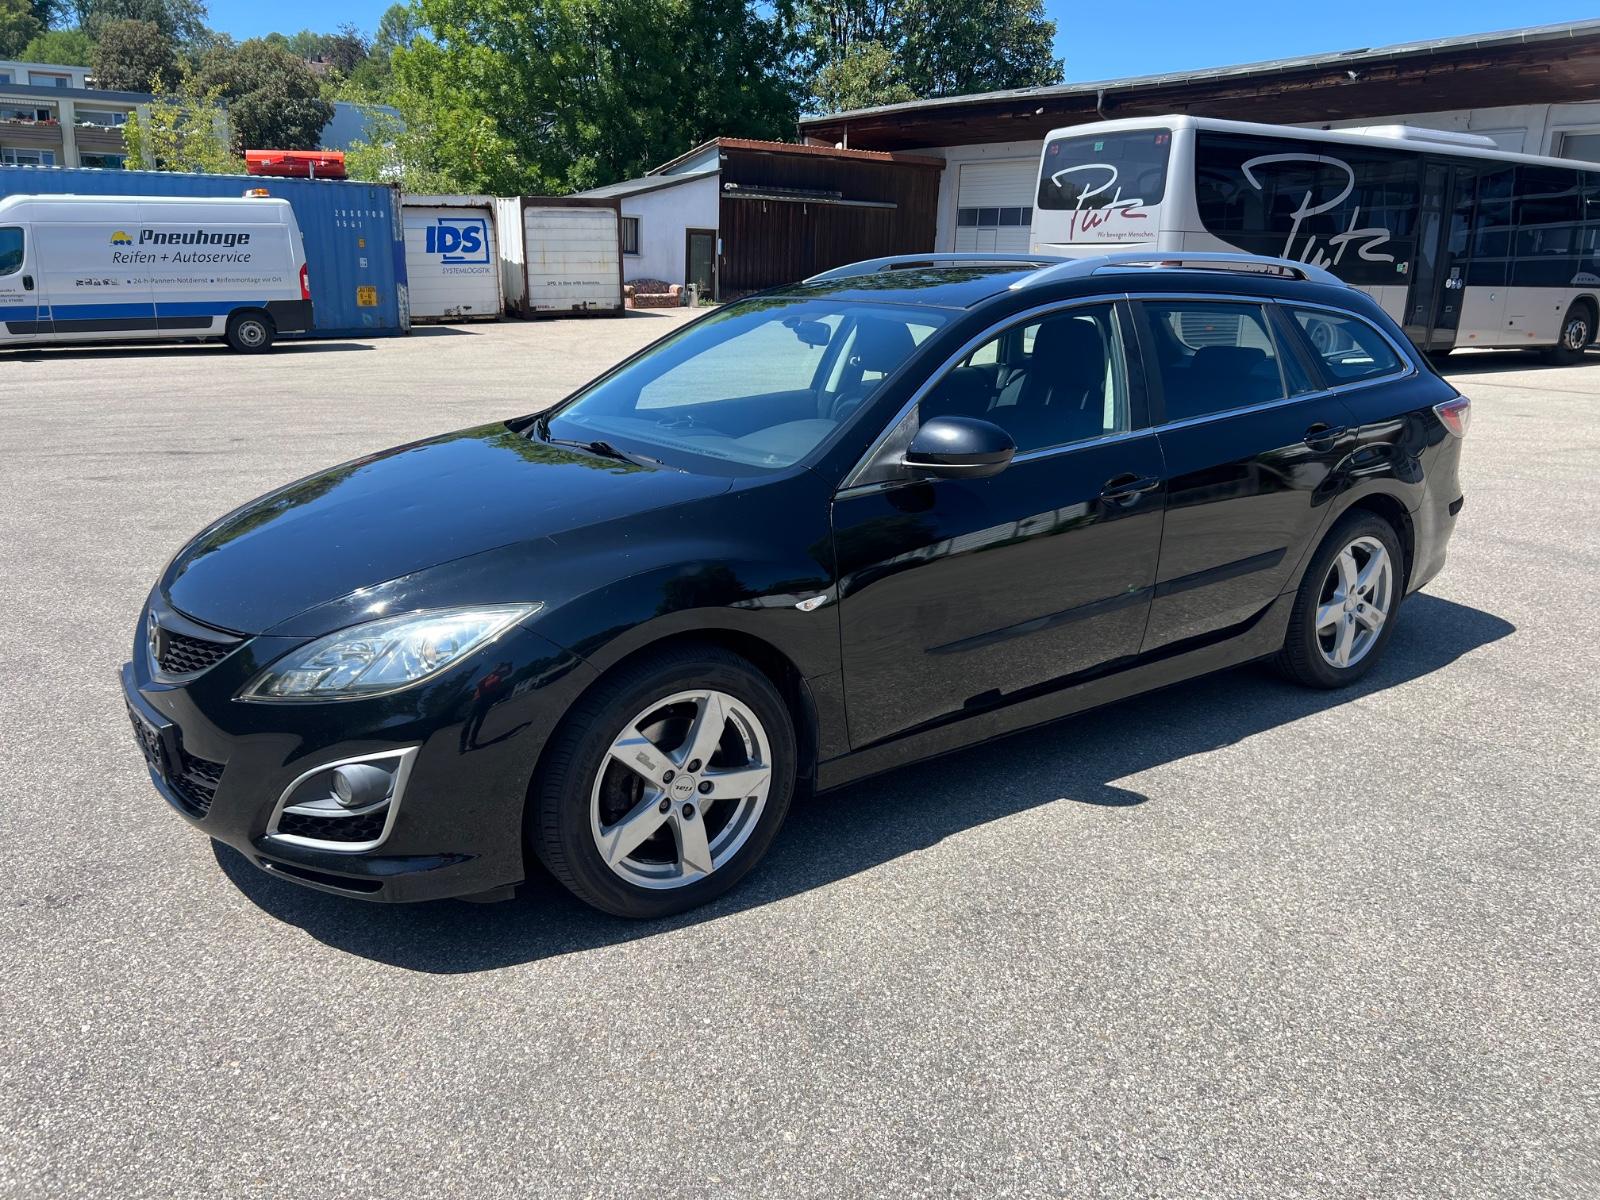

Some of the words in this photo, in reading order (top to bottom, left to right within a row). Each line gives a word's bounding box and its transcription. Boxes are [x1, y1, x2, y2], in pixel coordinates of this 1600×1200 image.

[138, 229, 250, 248] Pneuhage
[426, 226, 481, 253] IDS
[1106, 232, 1127, 240] bewegen
[112, 251, 156, 264] Reifen
[160, 254, 169, 262] +
[172, 251, 252, 263] Autoservice
